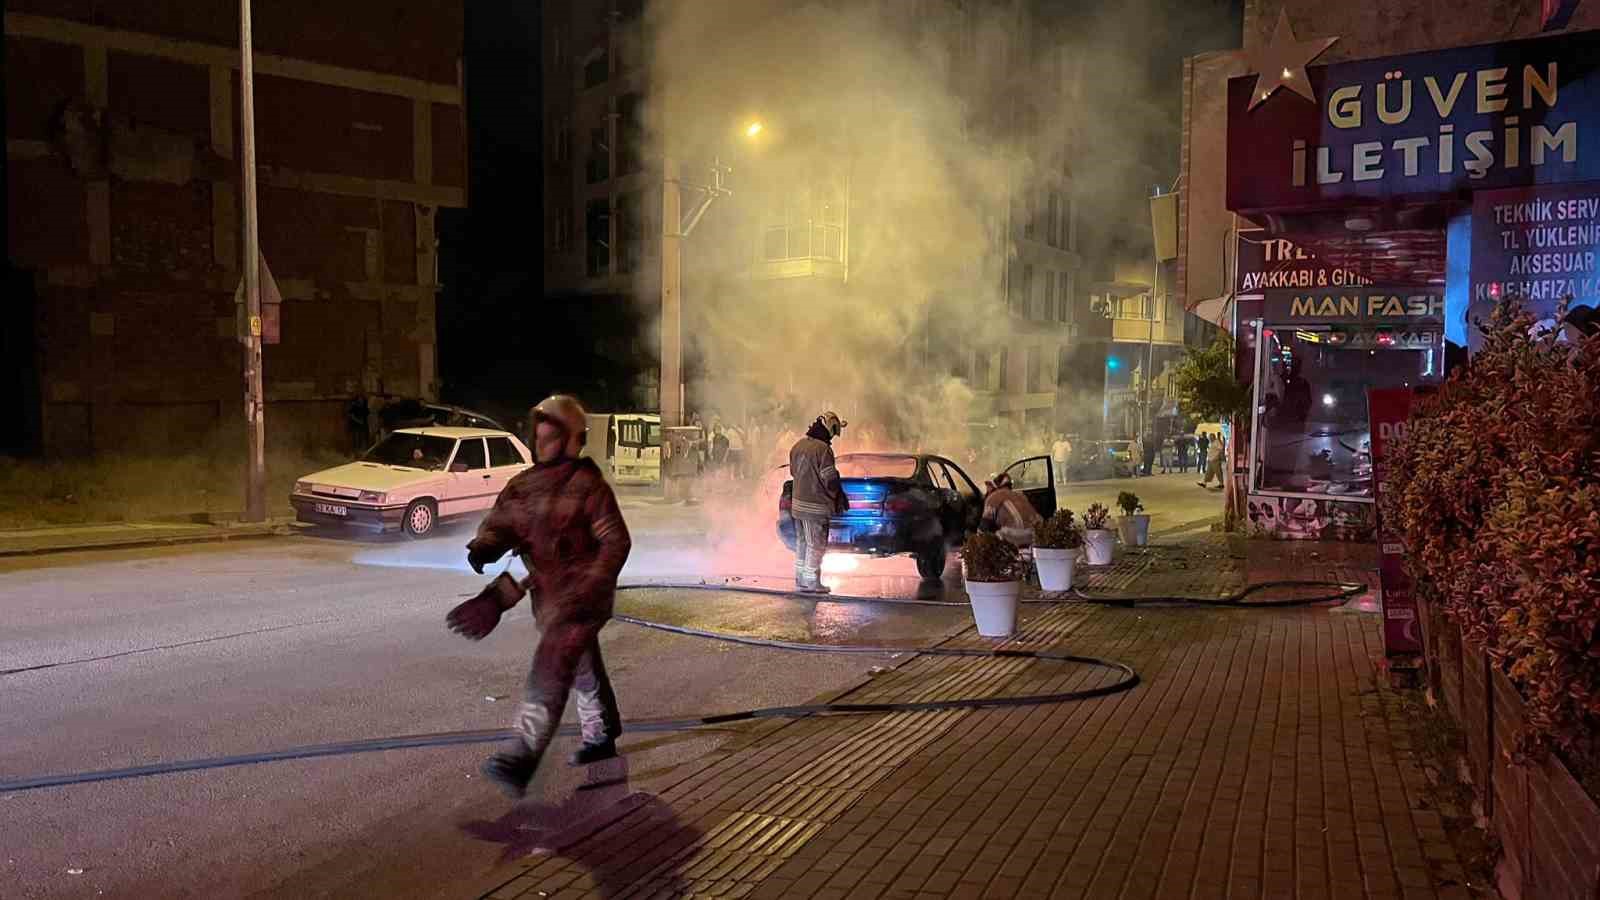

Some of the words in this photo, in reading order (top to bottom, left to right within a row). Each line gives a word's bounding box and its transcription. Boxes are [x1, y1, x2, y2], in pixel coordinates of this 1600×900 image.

[1328, 62, 1558, 129] GÜVEN
[1293, 116, 1577, 187] İLETİŞİM
[1494, 197, 1553, 225] TEKNİK
[1557, 198, 1600, 220] SERV
[1502, 231, 1519, 249] TL
[1510, 251, 1594, 275] AKSESUAR
[1242, 269, 1314, 289] AYAKKABI
[1317, 268, 1328, 286] &
[1290, 295, 1359, 316] MAN
